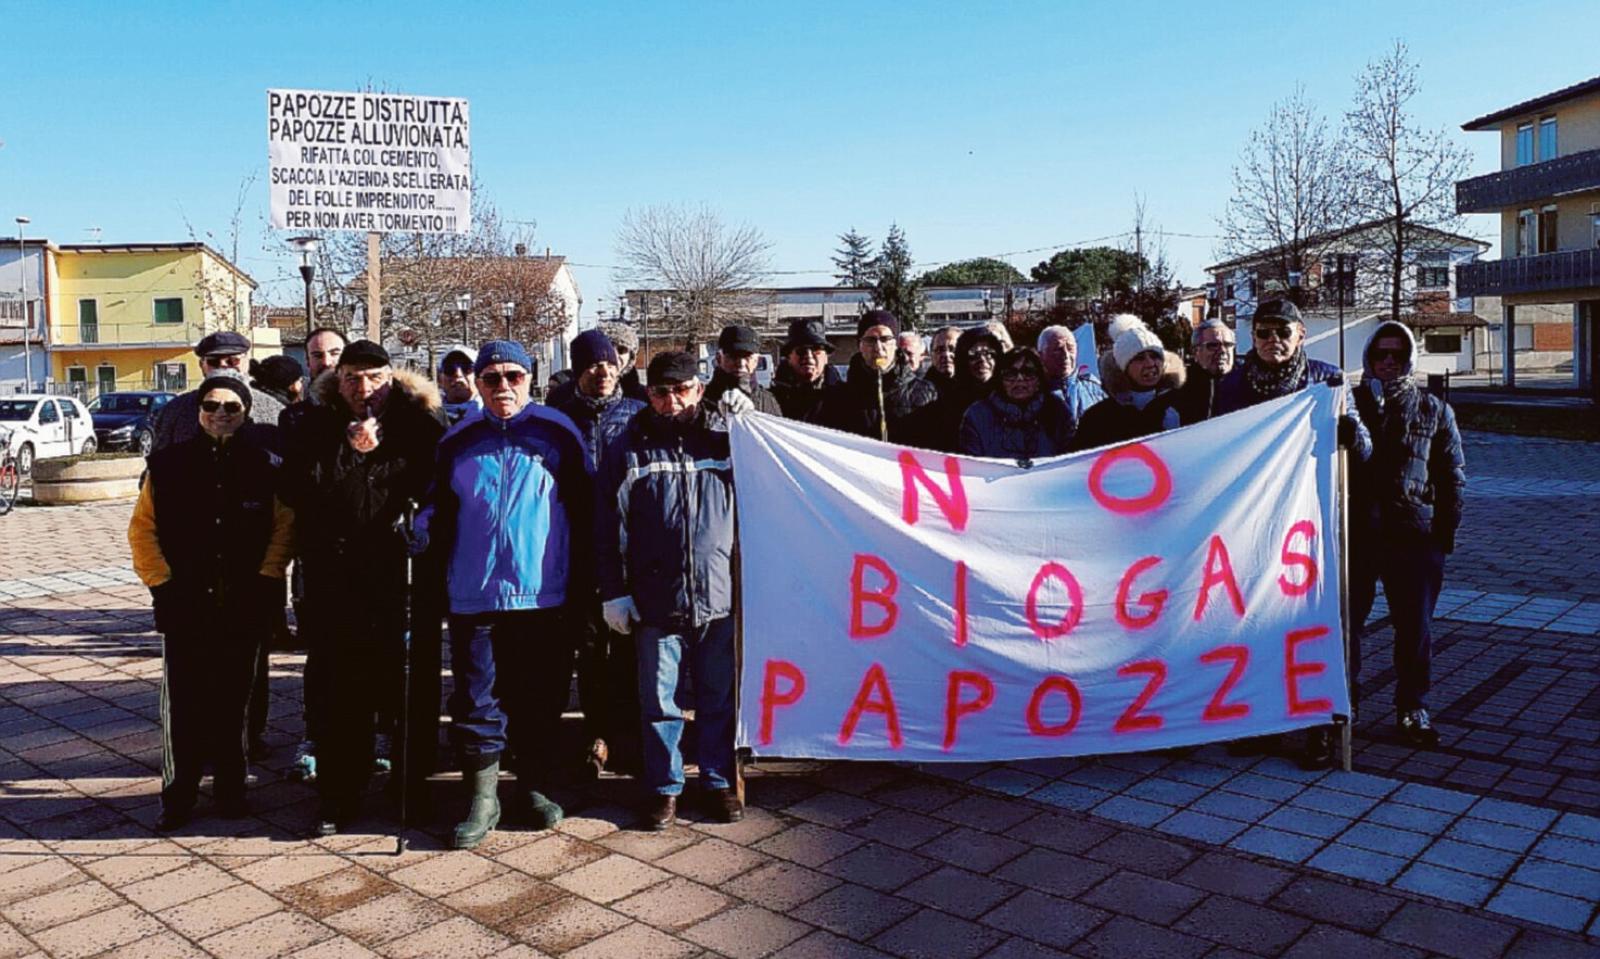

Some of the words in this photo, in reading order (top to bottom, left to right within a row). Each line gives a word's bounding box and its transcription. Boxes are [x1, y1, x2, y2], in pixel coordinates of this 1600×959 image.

[270, 94, 355, 119] PAPOZZE
[270, 119, 346, 143] PAPOZZE
[301, 147, 350, 164] RIFATTA
[354, 149, 377, 166] COL
[381, 150, 440, 169] CEMENTO,
[272, 168, 325, 185] SCACCIA
[329, 171, 389, 187] L'AZIENDA
[393, 173, 468, 190] SCELLERATA
[289, 190, 311, 206] DEL
[315, 191, 352, 207] FOLLE
[286, 211, 310, 227] PER
[314, 213, 339, 228] NON
[343, 214, 377, 230] AVER
[379, 215, 443, 231] TORMENTO
[898, 443, 1173, 531] NO
[850, 519, 1319, 647] BIOGAS
[759, 626, 1333, 751] PAPOZZE
